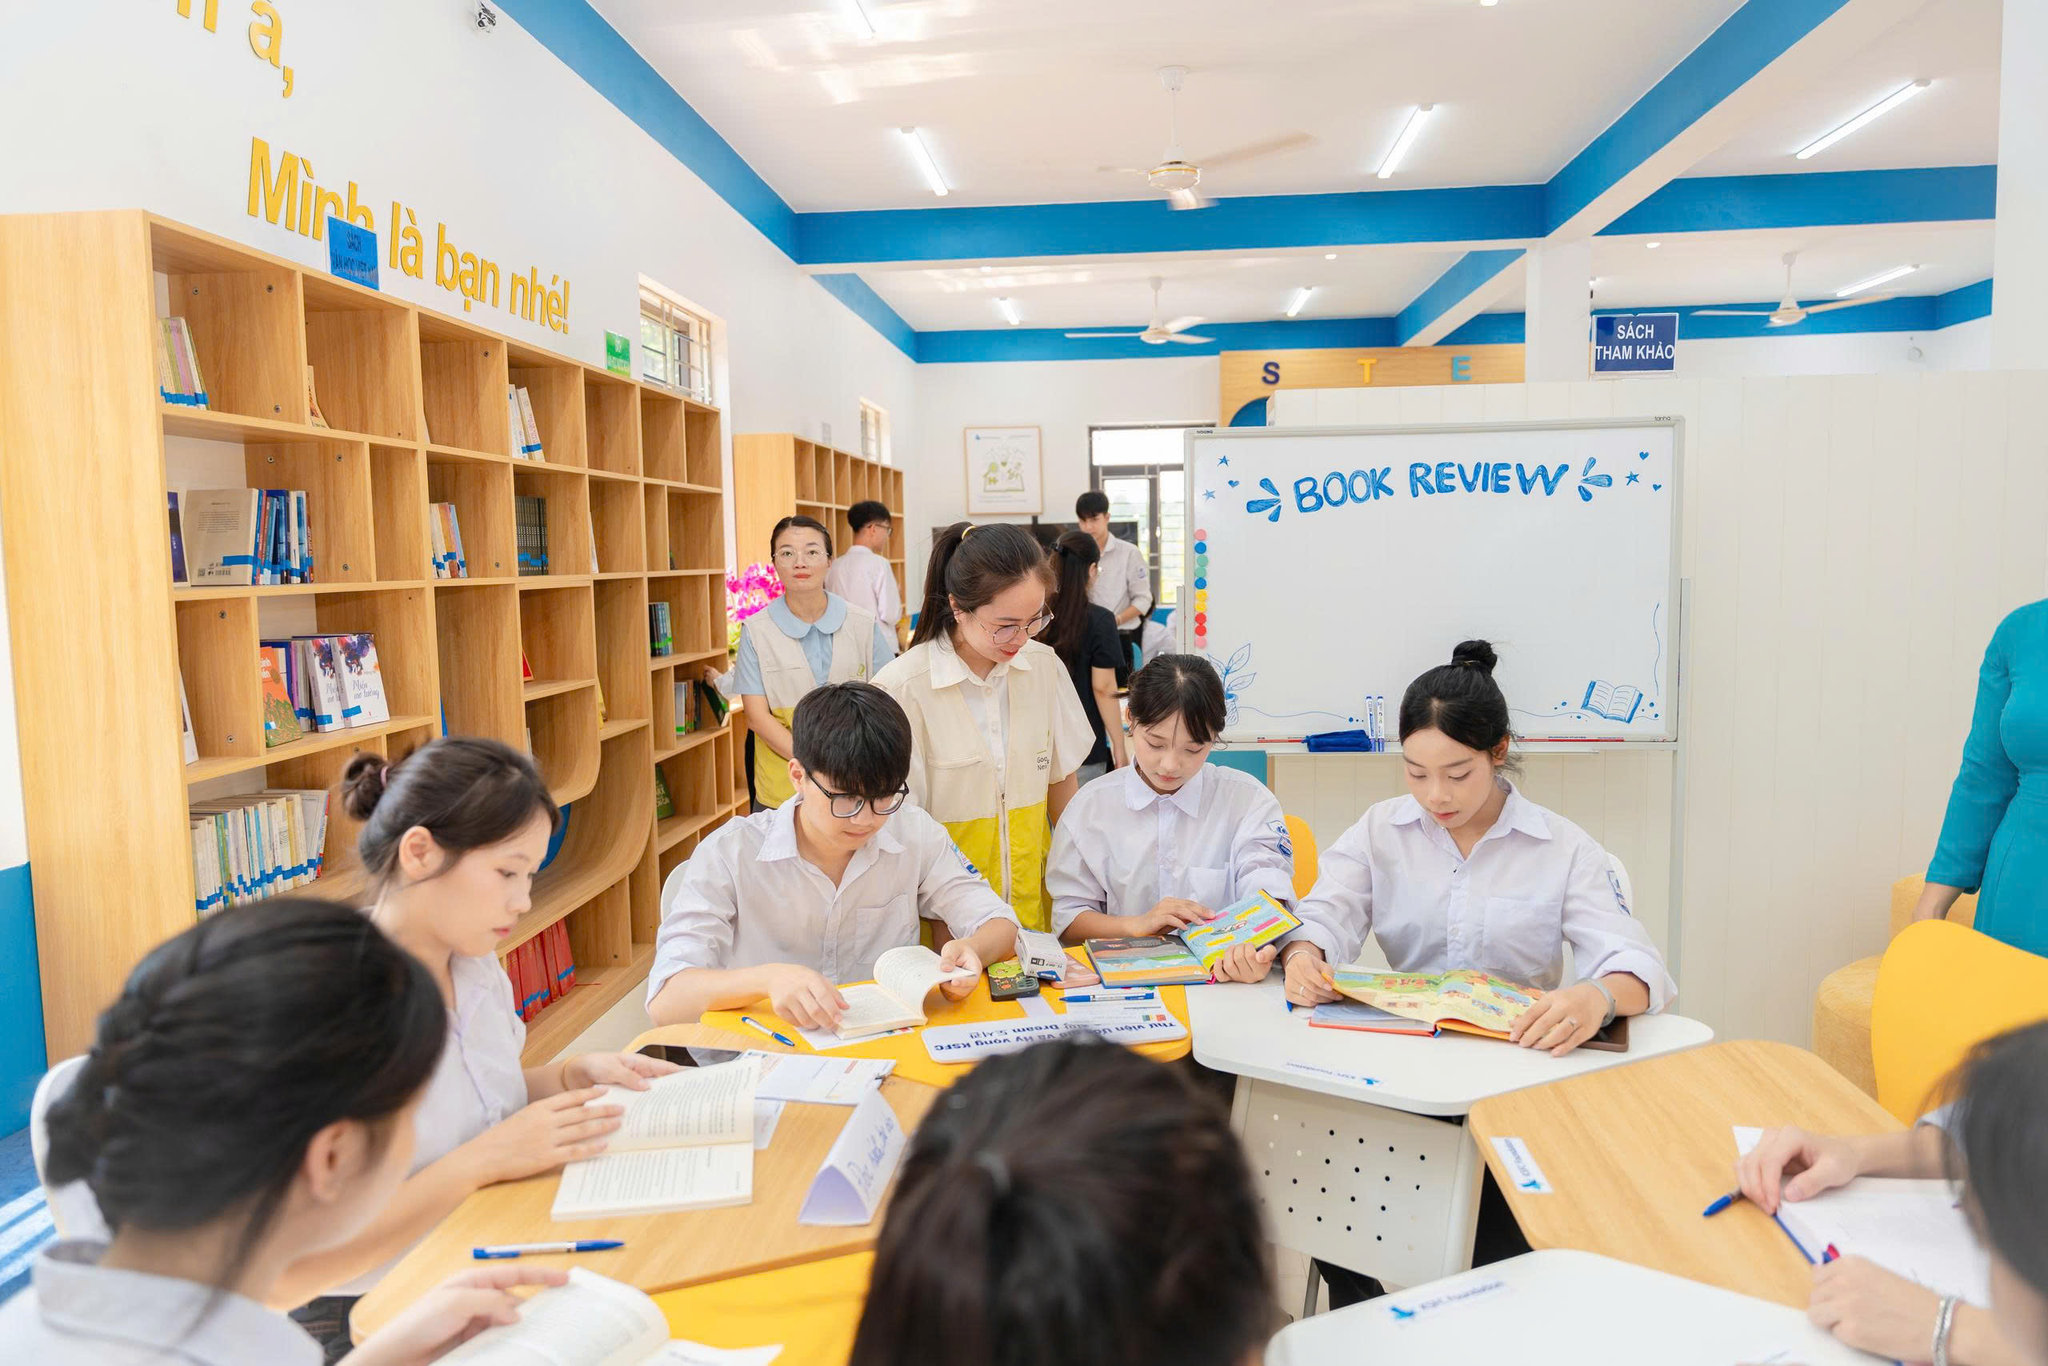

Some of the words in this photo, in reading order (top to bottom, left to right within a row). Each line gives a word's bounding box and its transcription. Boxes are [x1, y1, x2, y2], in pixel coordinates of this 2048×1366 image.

[248, 136, 375, 242] Mình
[389, 200, 424, 280] là
[436, 222, 500, 312] bạn
[510, 266, 570, 335] nhé!
[1617, 321, 1654, 339] SÁCH
[1595, 345, 1633, 360] THAM
[1636, 341, 1675, 360] KHẢO
[1293, 466, 1395, 513] BOOK
[1409, 461, 1570, 497] REVIEW
[1011, 1023, 1059, 1034] Dream
[934, 1040, 972, 1051] KSFC
